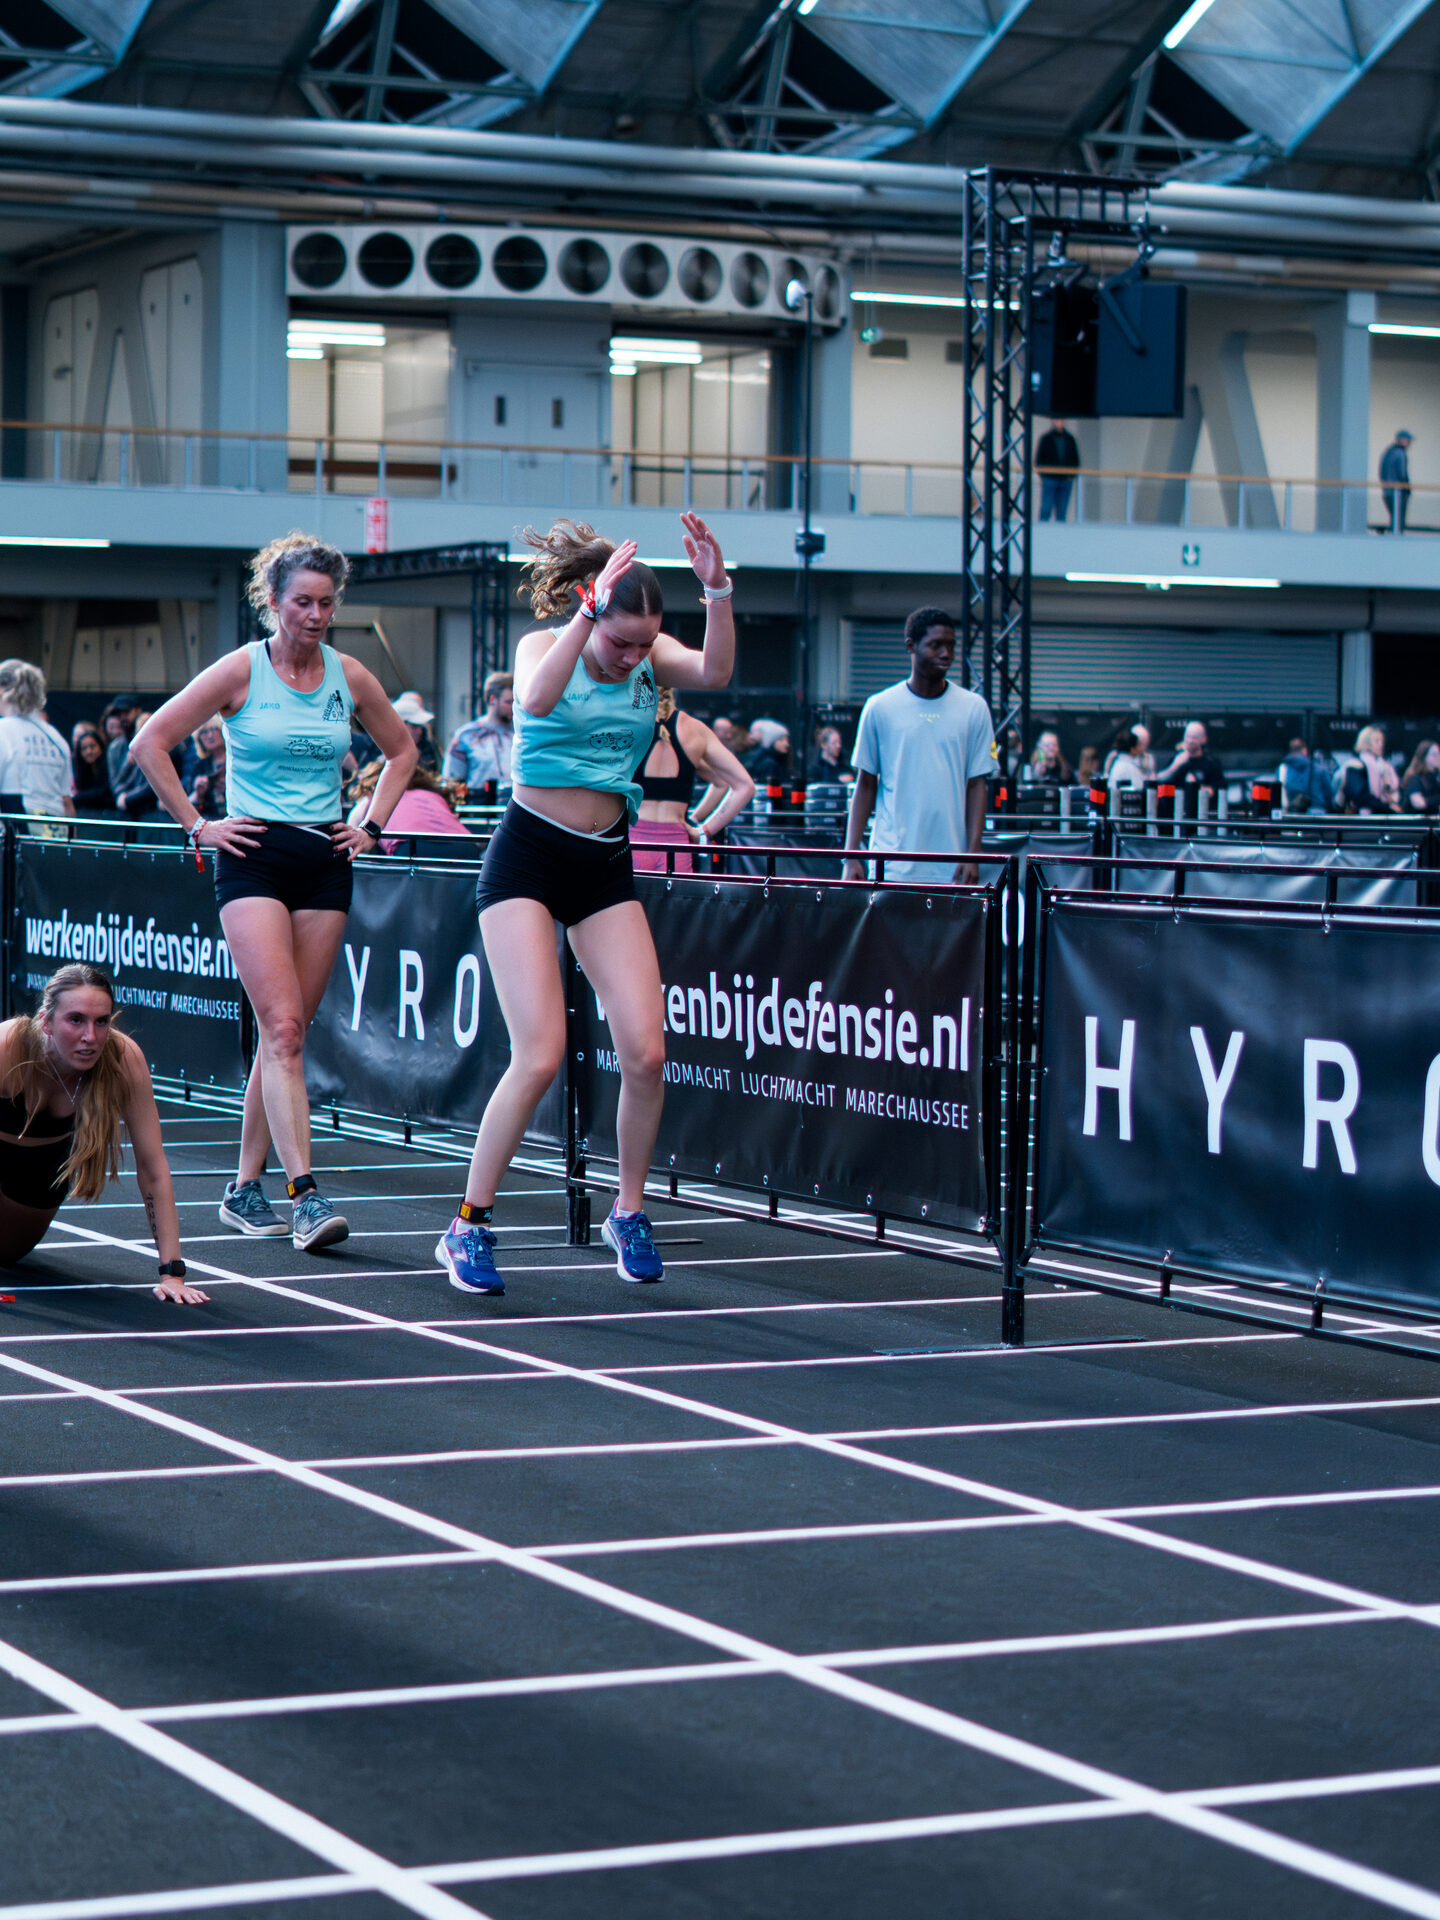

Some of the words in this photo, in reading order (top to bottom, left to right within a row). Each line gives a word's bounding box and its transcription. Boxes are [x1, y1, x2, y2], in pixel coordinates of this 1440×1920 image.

[170, 992, 240, 1020] MARECHAUSSEE
[344, 943, 481, 1048] YRO
[595, 971, 970, 1072] enbijdefensie.nl
[662, 1061, 731, 1091] NDMACHT
[741, 1071, 836, 1108] LUCHTMACHT
[845, 1087, 969, 1130] MARECHAUSSEE
